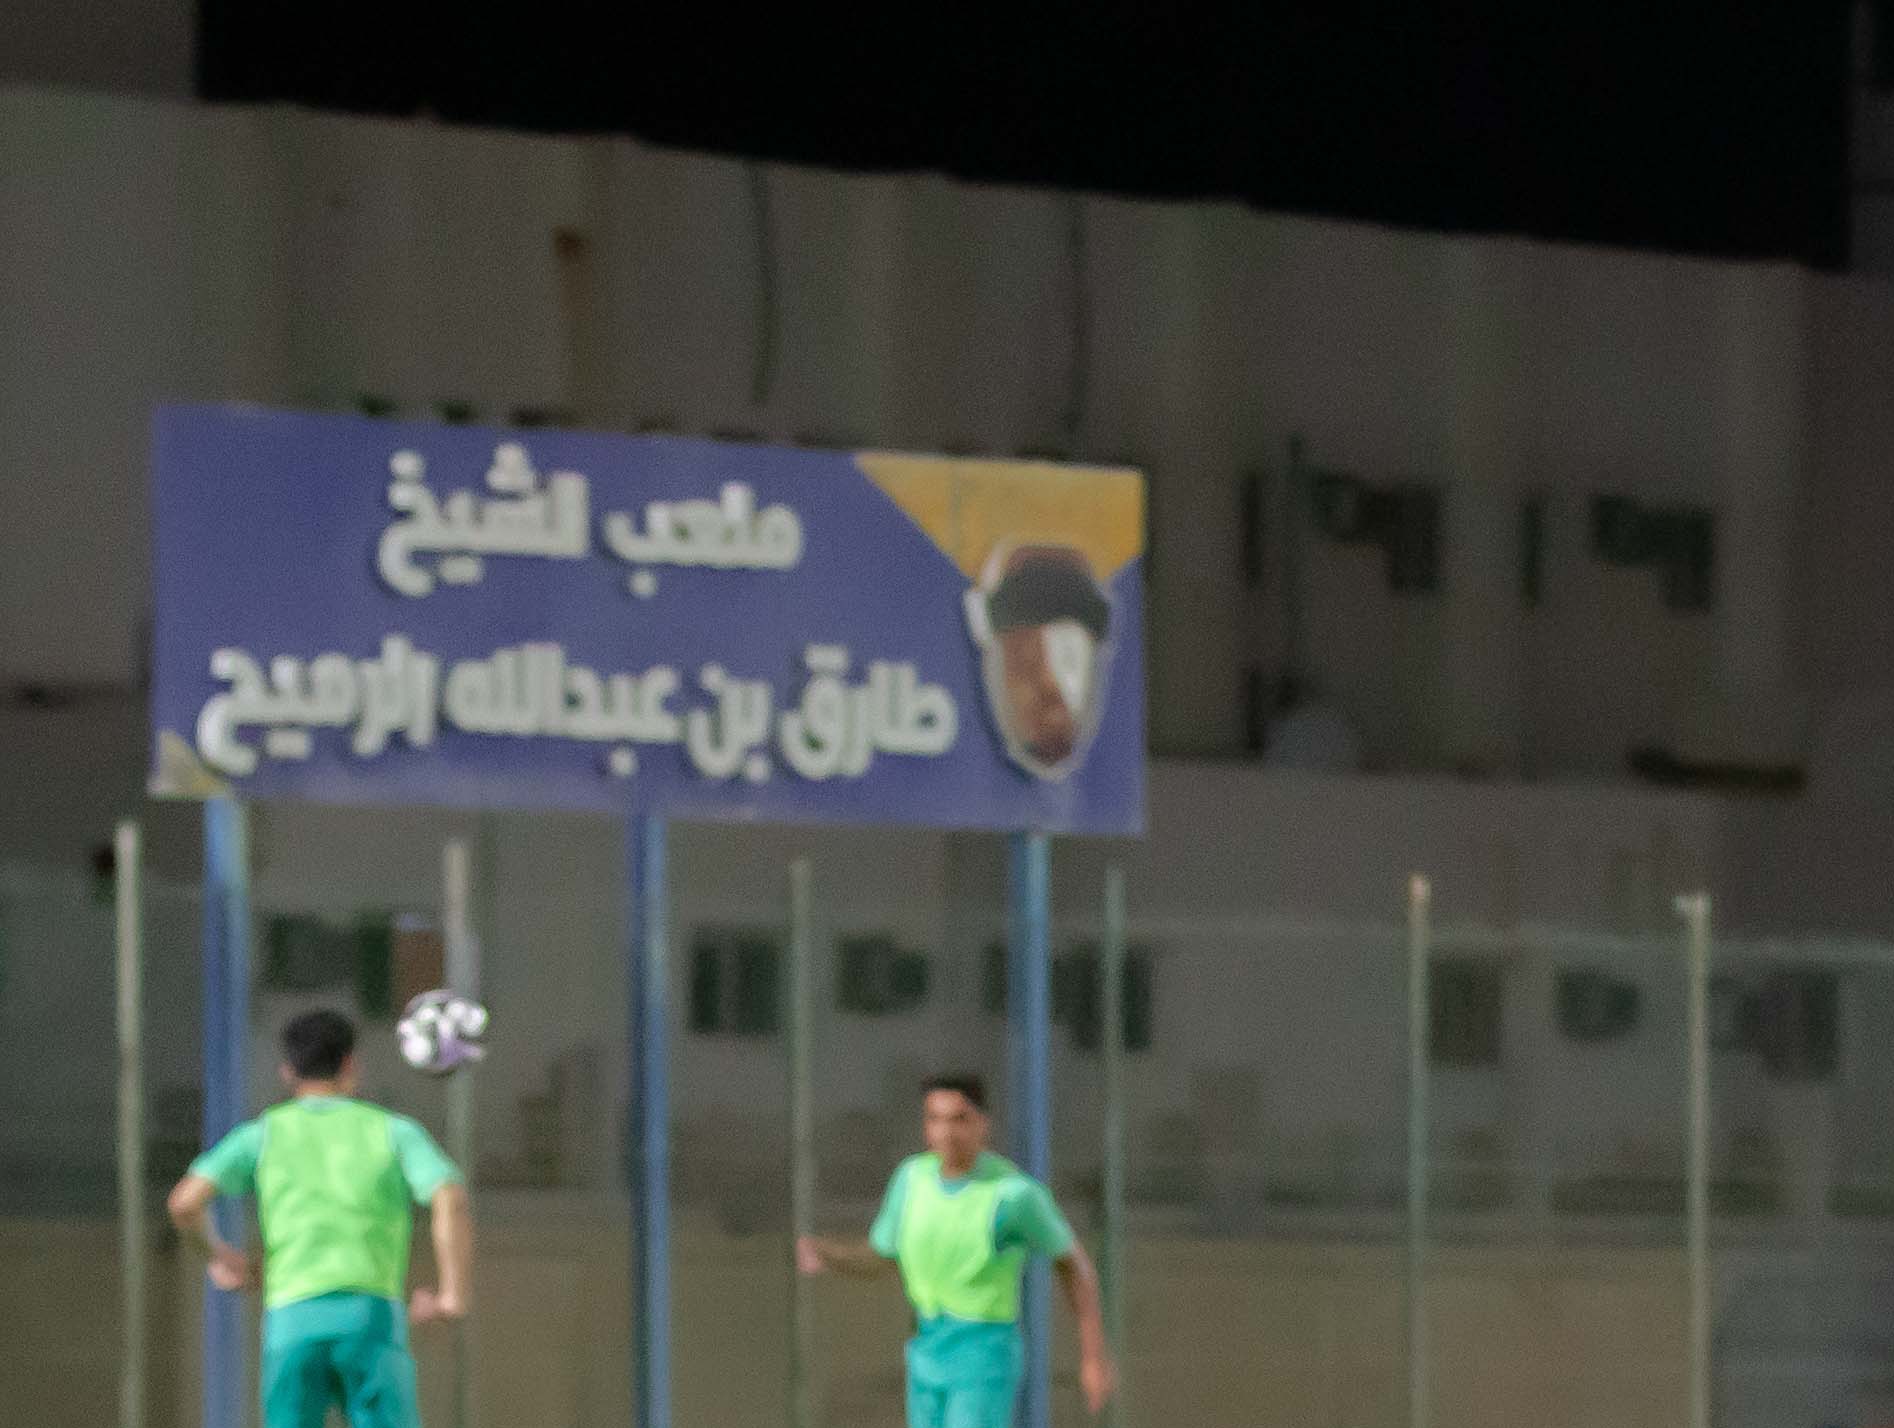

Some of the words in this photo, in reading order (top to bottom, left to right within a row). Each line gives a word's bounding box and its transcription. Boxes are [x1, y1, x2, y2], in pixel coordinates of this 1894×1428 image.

[377, 442, 590, 598] الشيخ
[605, 481, 802, 599] ملعب
[197, 633, 438, 776] الرميح
[446, 641, 680, 778] عبدالله
[687, 662, 772, 783] بن
[781, 643, 958, 779] طارق
